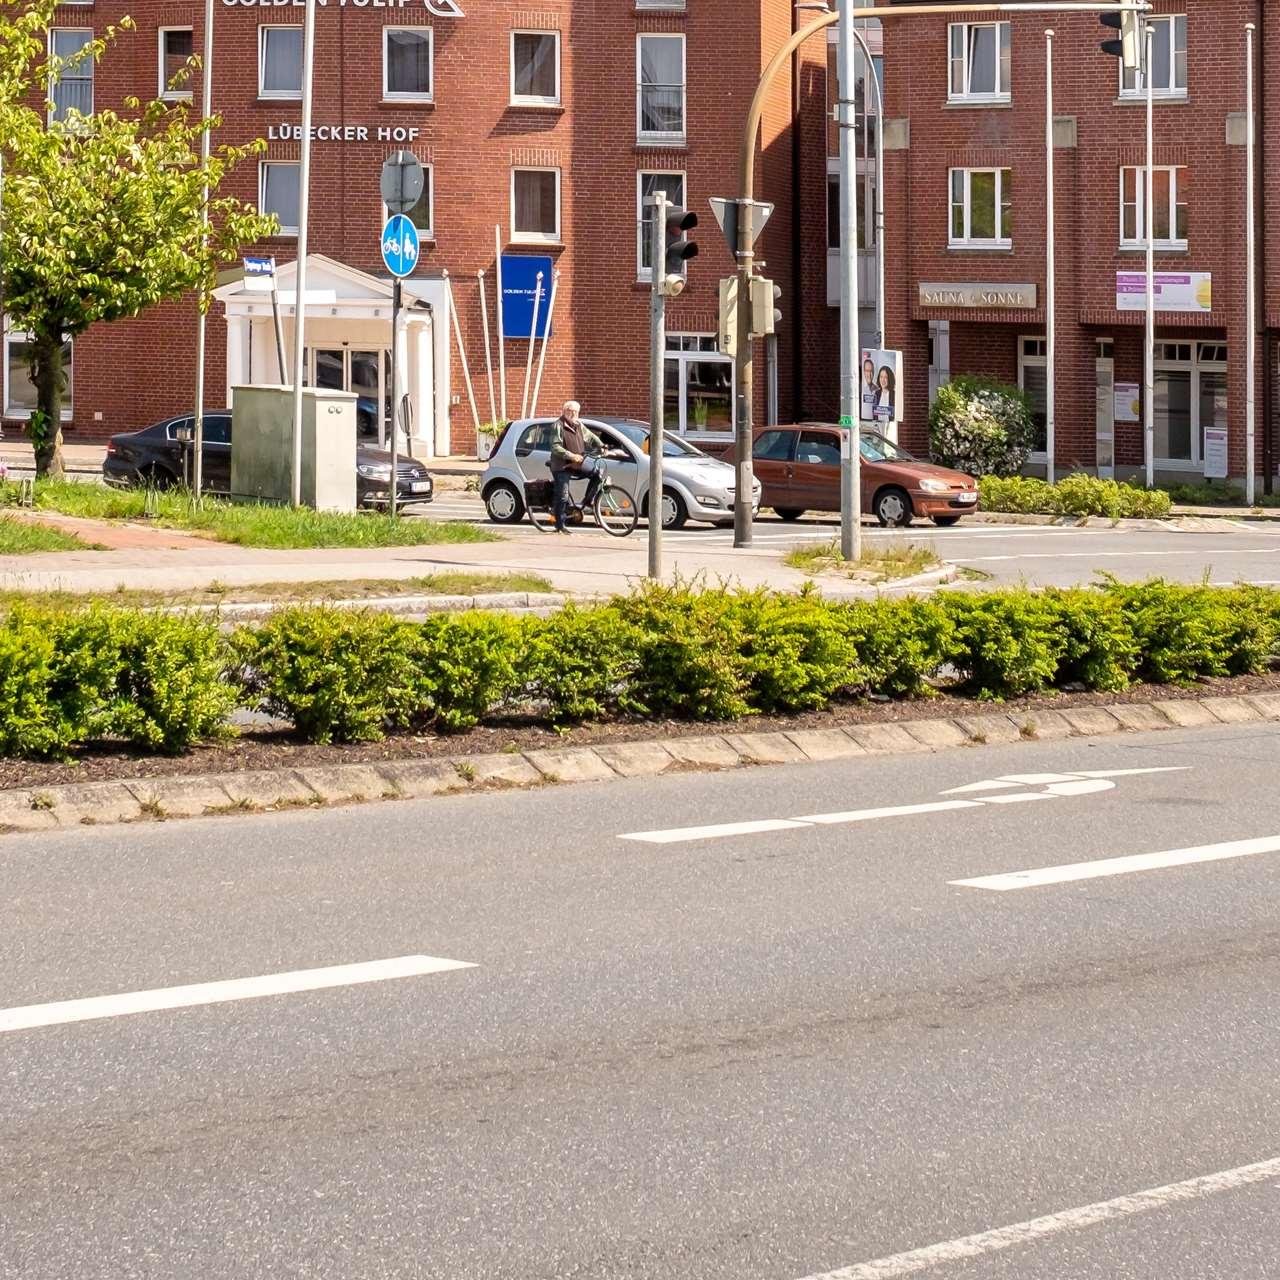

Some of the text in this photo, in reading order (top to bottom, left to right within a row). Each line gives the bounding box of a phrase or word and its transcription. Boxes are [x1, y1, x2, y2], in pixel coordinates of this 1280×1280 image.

[268, 123, 419, 141] LÜBECKER HOF
[925, 291, 965, 304] SAUNA
[981, 292, 1024, 305] SONNE
